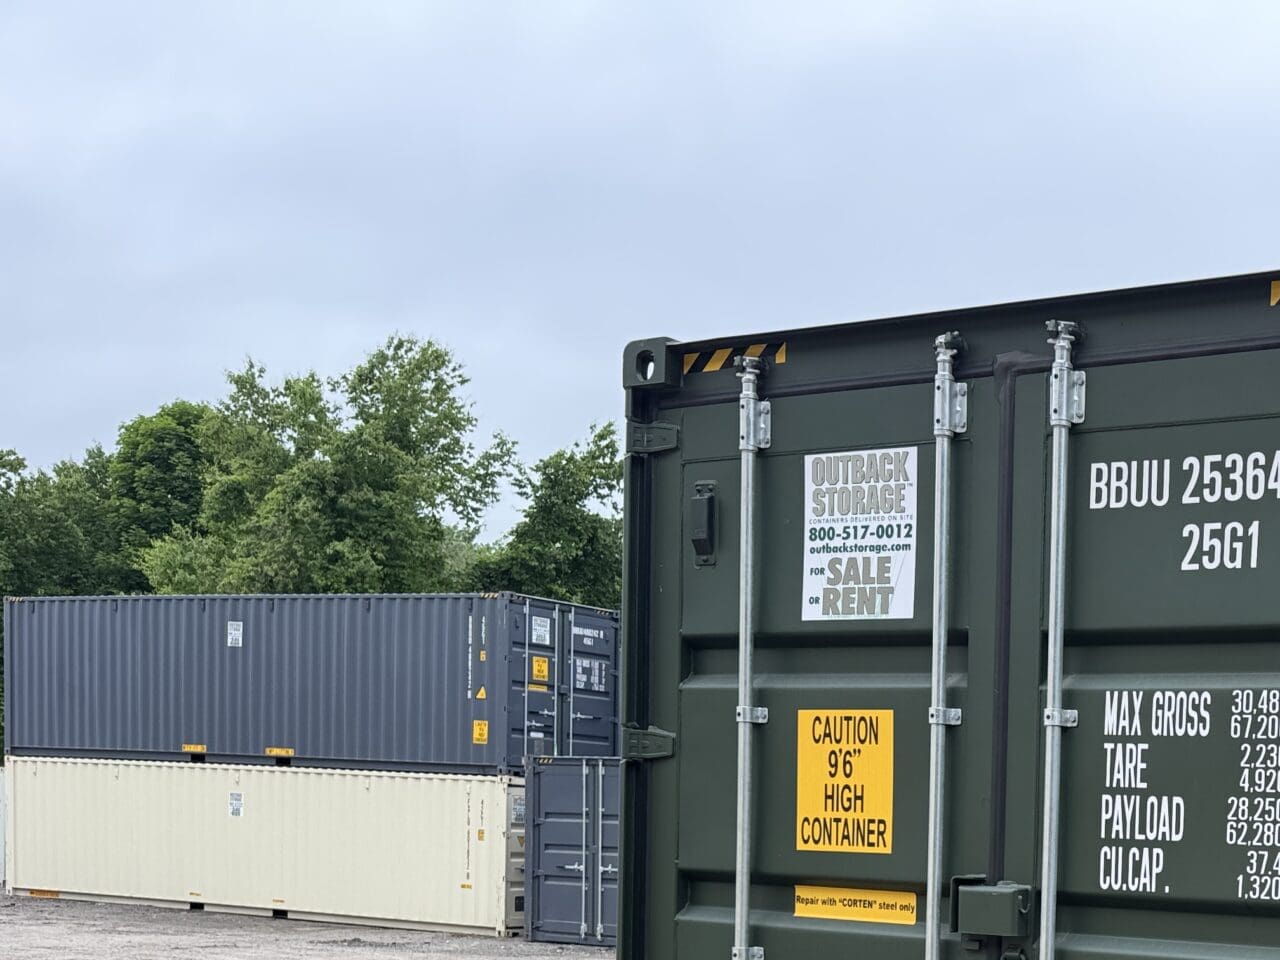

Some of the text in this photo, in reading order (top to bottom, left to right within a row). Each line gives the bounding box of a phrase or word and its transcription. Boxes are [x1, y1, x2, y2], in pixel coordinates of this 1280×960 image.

[811, 451, 910, 486] OUTBACK
[1089, 458, 1170, 509] BBUU
[812, 484, 906, 517] STORAGE
[809, 516, 848, 525] CONTAINERS
[850, 515, 885, 523] DELIVERED
[809, 523, 913, 541] 800-517-0012
[810, 542, 911, 554] outbackstorage.com
[1181, 520, 1260, 571] 25G1
[810, 556, 891, 586] FOR SALE
[809, 586, 894, 616] OR RENT
[1104, 690, 1143, 736] MAX
[1151, 691, 1211, 737] GROSS
[812, 715, 879, 745] CAUTION
[1104, 743, 1149, 789] TARE
[824, 783, 865, 813] HIGH
[801, 817, 887, 848] CONTAINER
[1100, 794, 1184, 841] PAYLOAD
[1099, 846, 1170, 894] CU.CAP.
[796, 895, 819, 905] Repair
[821, 896, 837, 906] with
[878, 901, 898, 911] steel
[899, 902, 915, 914] only
